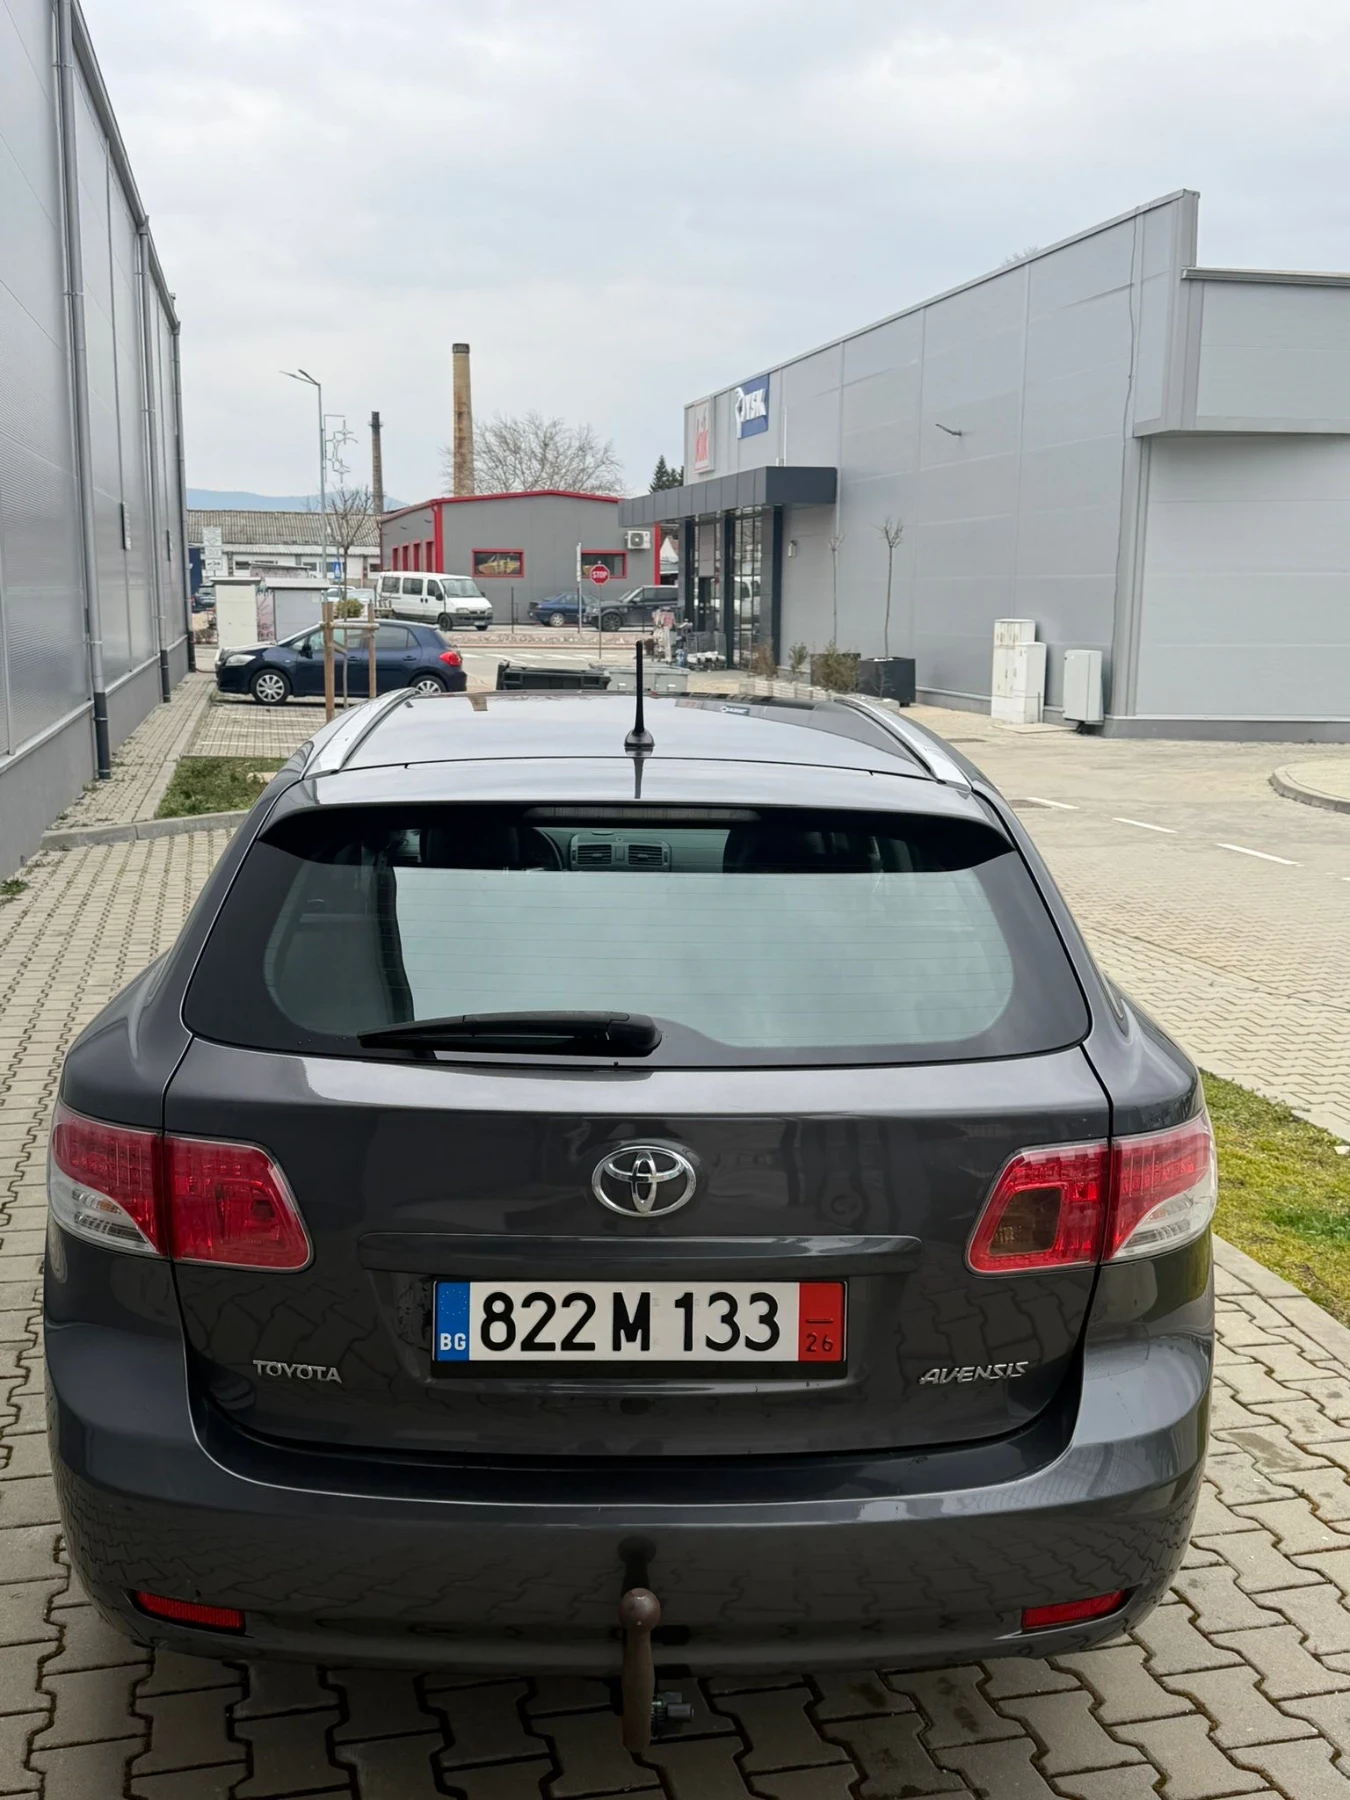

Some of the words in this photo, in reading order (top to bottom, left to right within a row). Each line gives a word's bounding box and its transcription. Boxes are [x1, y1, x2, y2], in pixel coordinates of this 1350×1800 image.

[592, 570, 608, 579] STOP
[480, 1292, 597, 1352] 822
[612, 1292, 651, 1352] M
[674, 1292, 780, 1352] 133
[439, 1332, 467, 1351] BG
[806, 1333, 834, 1353] 26
[252, 1359, 342, 1384] TOYOTA
[919, 1360, 1029, 1385] AVENSIS
